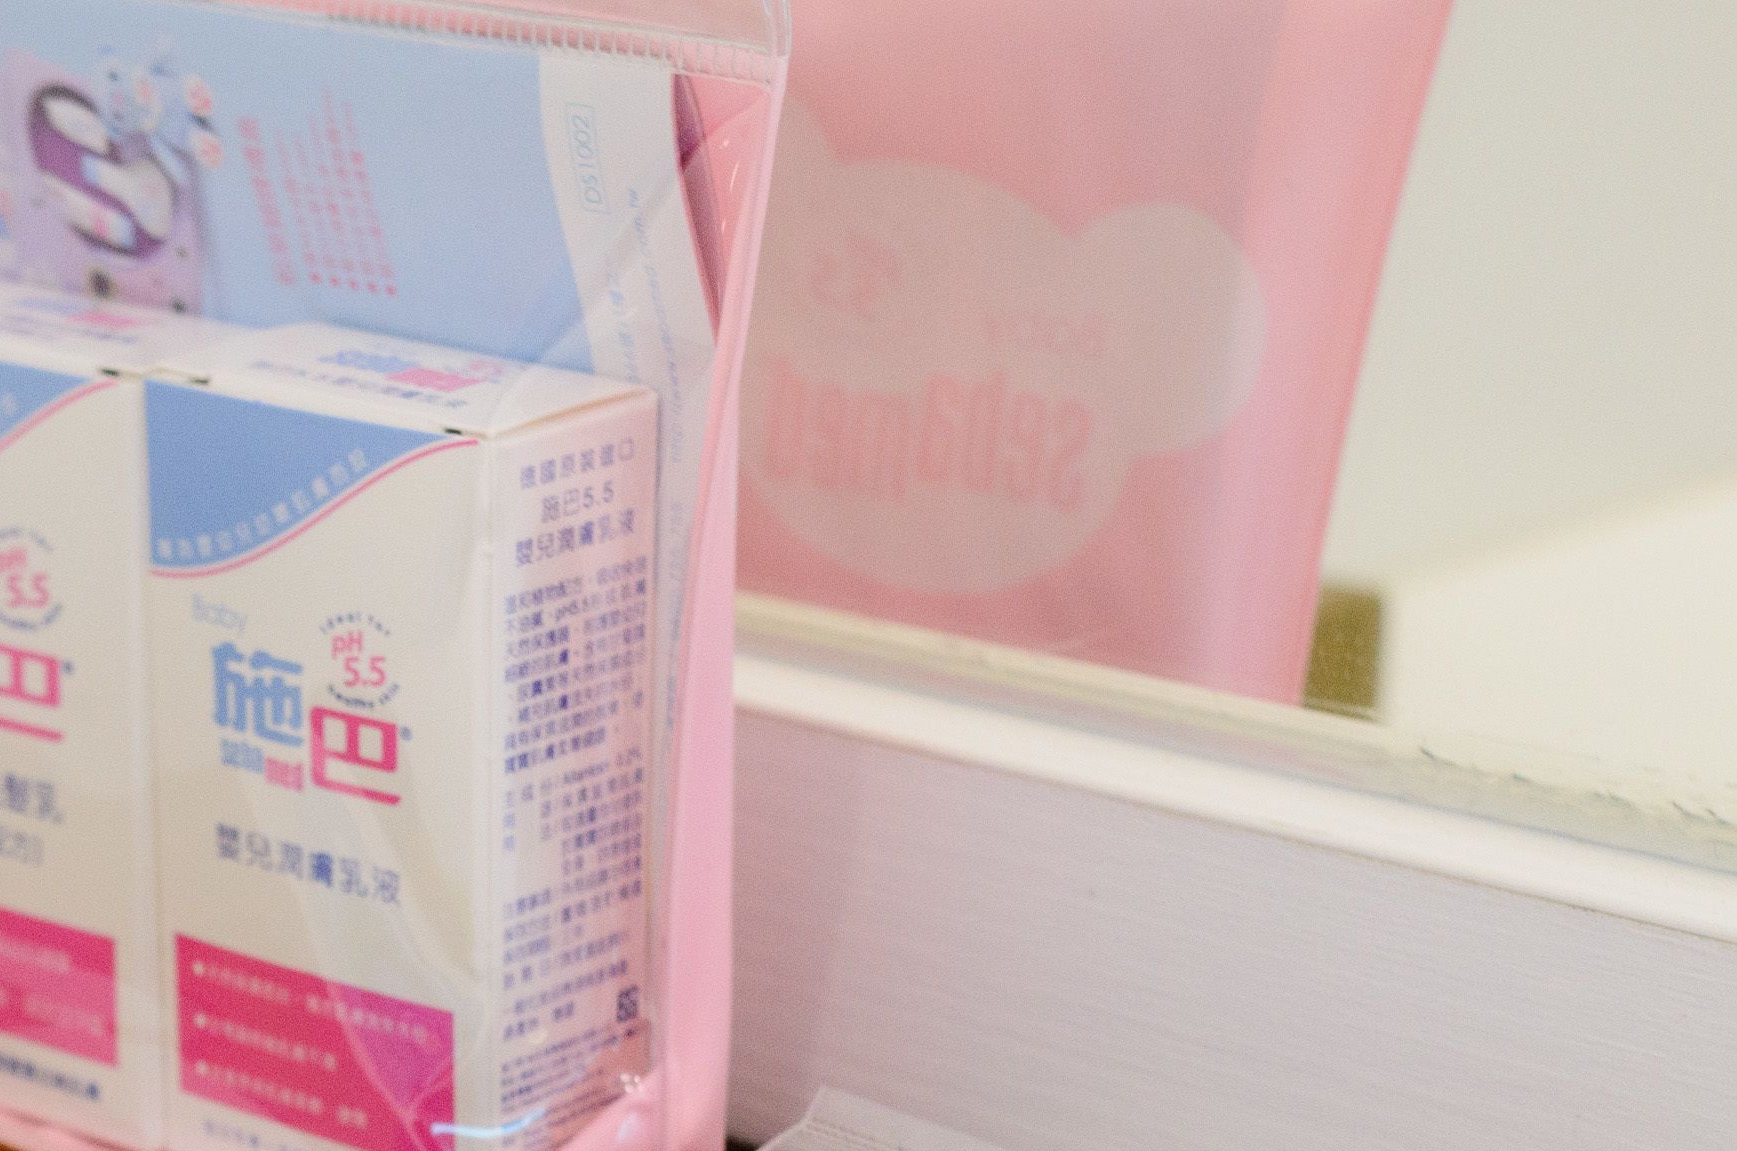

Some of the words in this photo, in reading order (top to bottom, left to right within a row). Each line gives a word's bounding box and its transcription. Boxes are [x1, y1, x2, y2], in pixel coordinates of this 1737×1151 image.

[330, 630, 365, 660] pH
[343, 655, 388, 689] 5.5
[211, 641, 402, 807] 施巴
